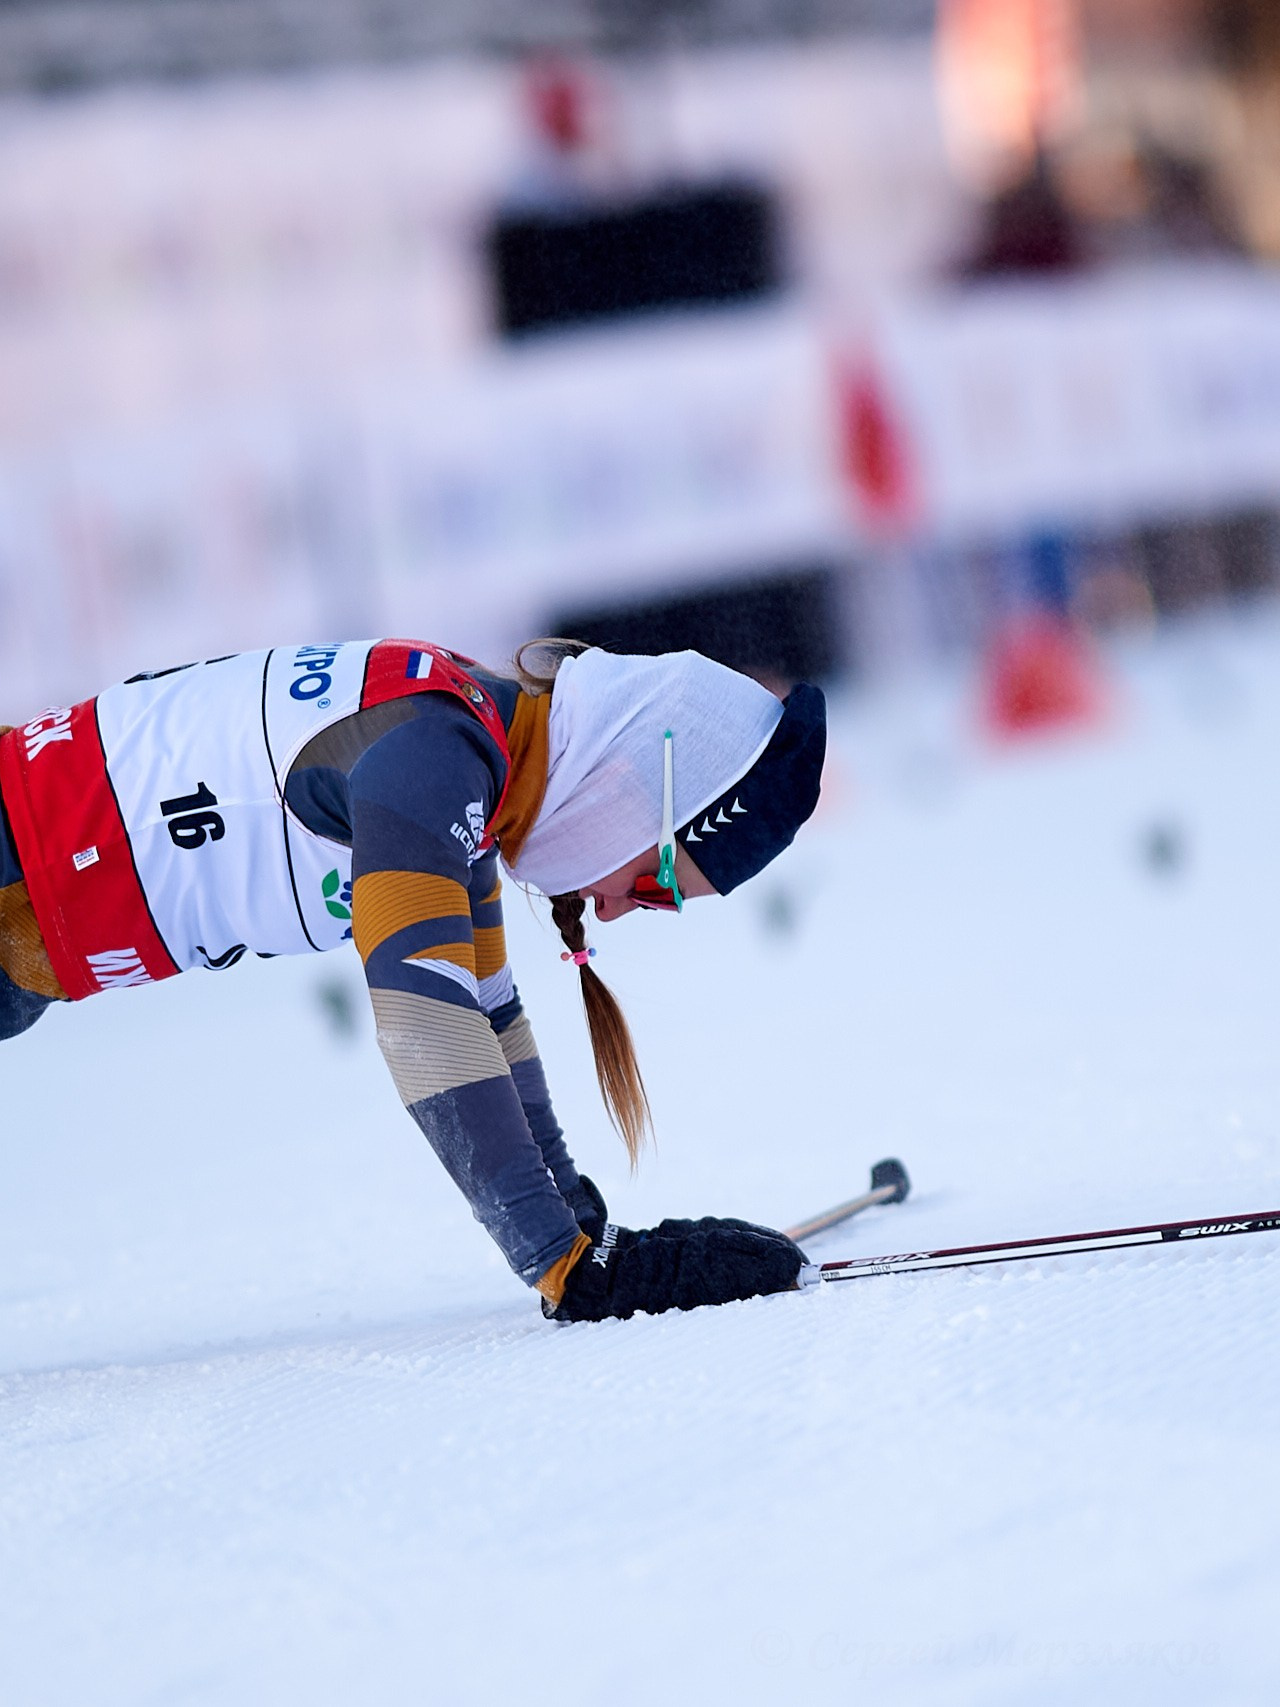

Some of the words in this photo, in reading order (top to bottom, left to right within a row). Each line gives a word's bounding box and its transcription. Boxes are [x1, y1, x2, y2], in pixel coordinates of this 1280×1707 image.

[160, 781, 225, 849] 16
[1178, 1221, 1253, 1238] SWIX
[847, 1251, 938, 1267] SWIX
